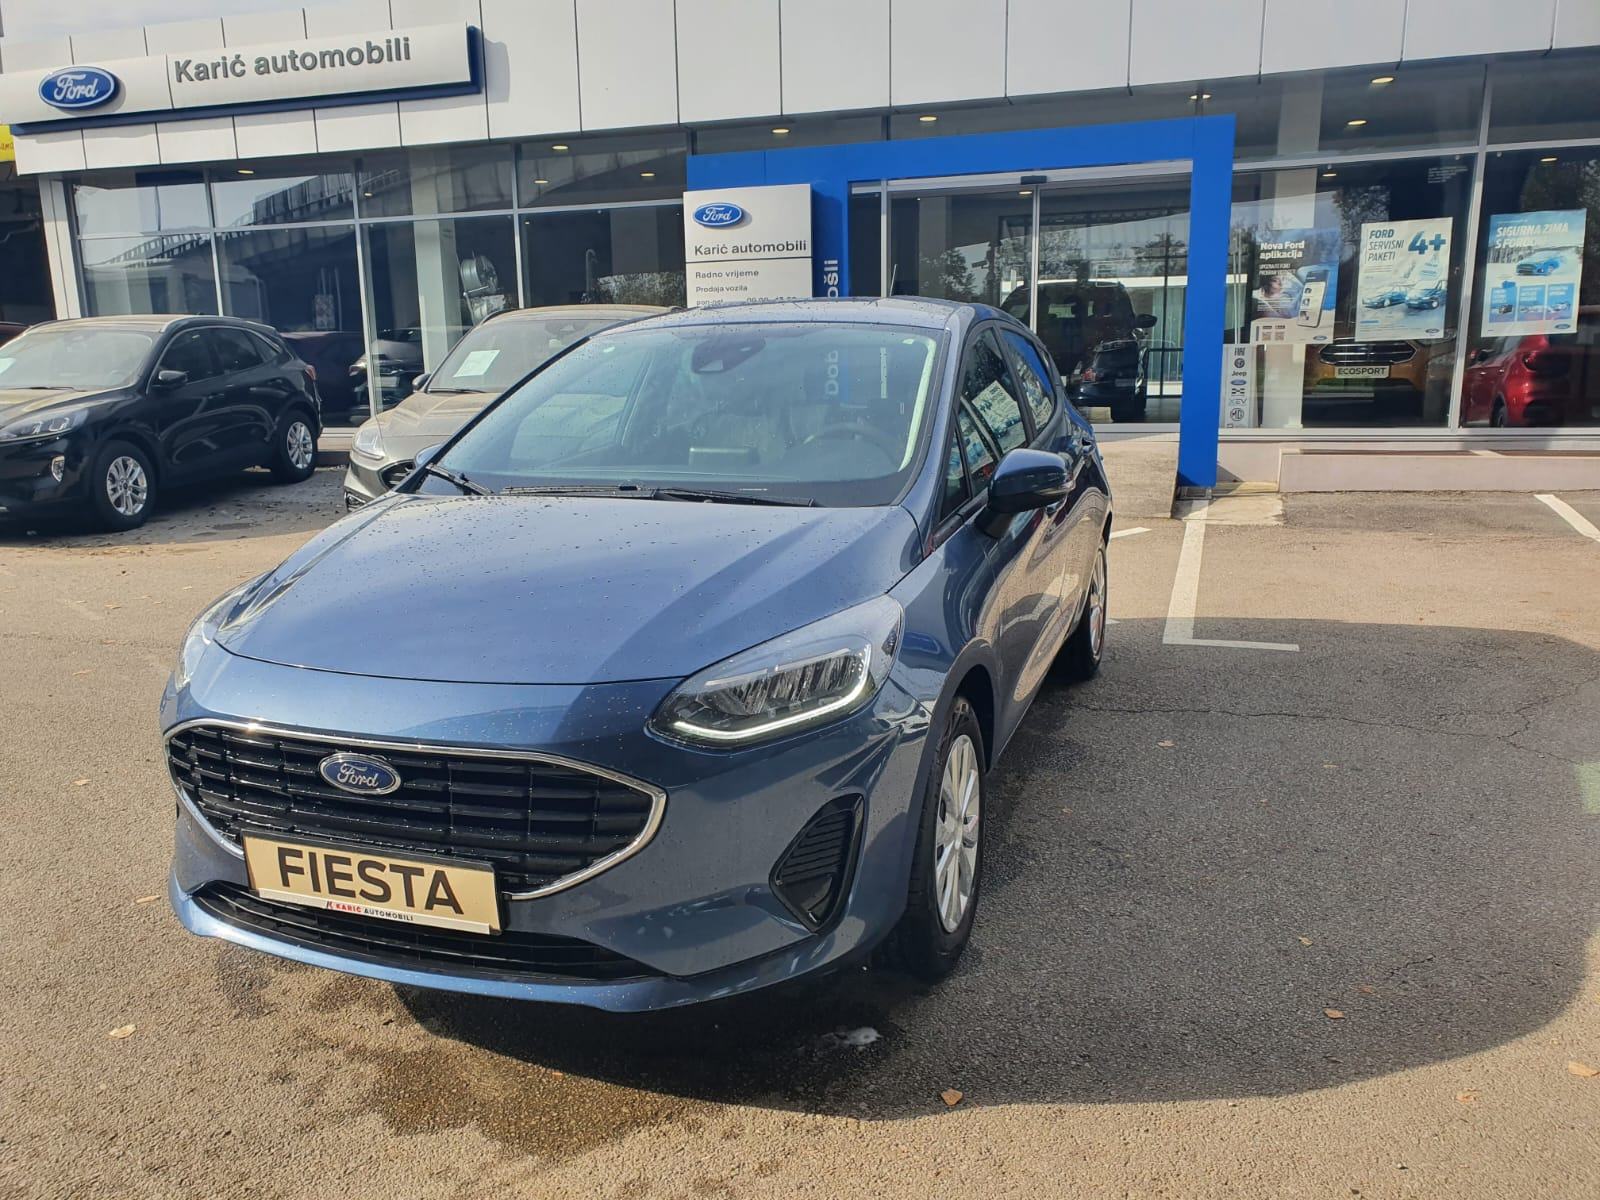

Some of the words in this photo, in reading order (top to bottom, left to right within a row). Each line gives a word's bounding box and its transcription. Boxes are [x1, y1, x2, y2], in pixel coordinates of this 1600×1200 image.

[174, 54, 246, 83] Karić
[254, 36, 411, 76] automobili
[53, 73, 99, 100] Ford
[702, 207, 732, 222] Ford
[1369, 229, 1395, 240] FORD
[694, 244, 729, 256] Karić
[731, 240, 807, 254] automobili
[1260, 242, 1284, 251] Nova
[1284, 240, 1305, 250] Ford
[1368, 240, 1405, 251] SERVISNI
[1259, 249, 1303, 260] aplikacija
[1367, 252, 1396, 261] PAKETI
[725, 270, 759, 278] vrijeme
[1337, 367, 1387, 375] ECOSPORT
[337, 763, 380, 788] Ford
[277, 846, 464, 915] FIESTA
[364, 908, 414, 921] AUTOMOBILI
